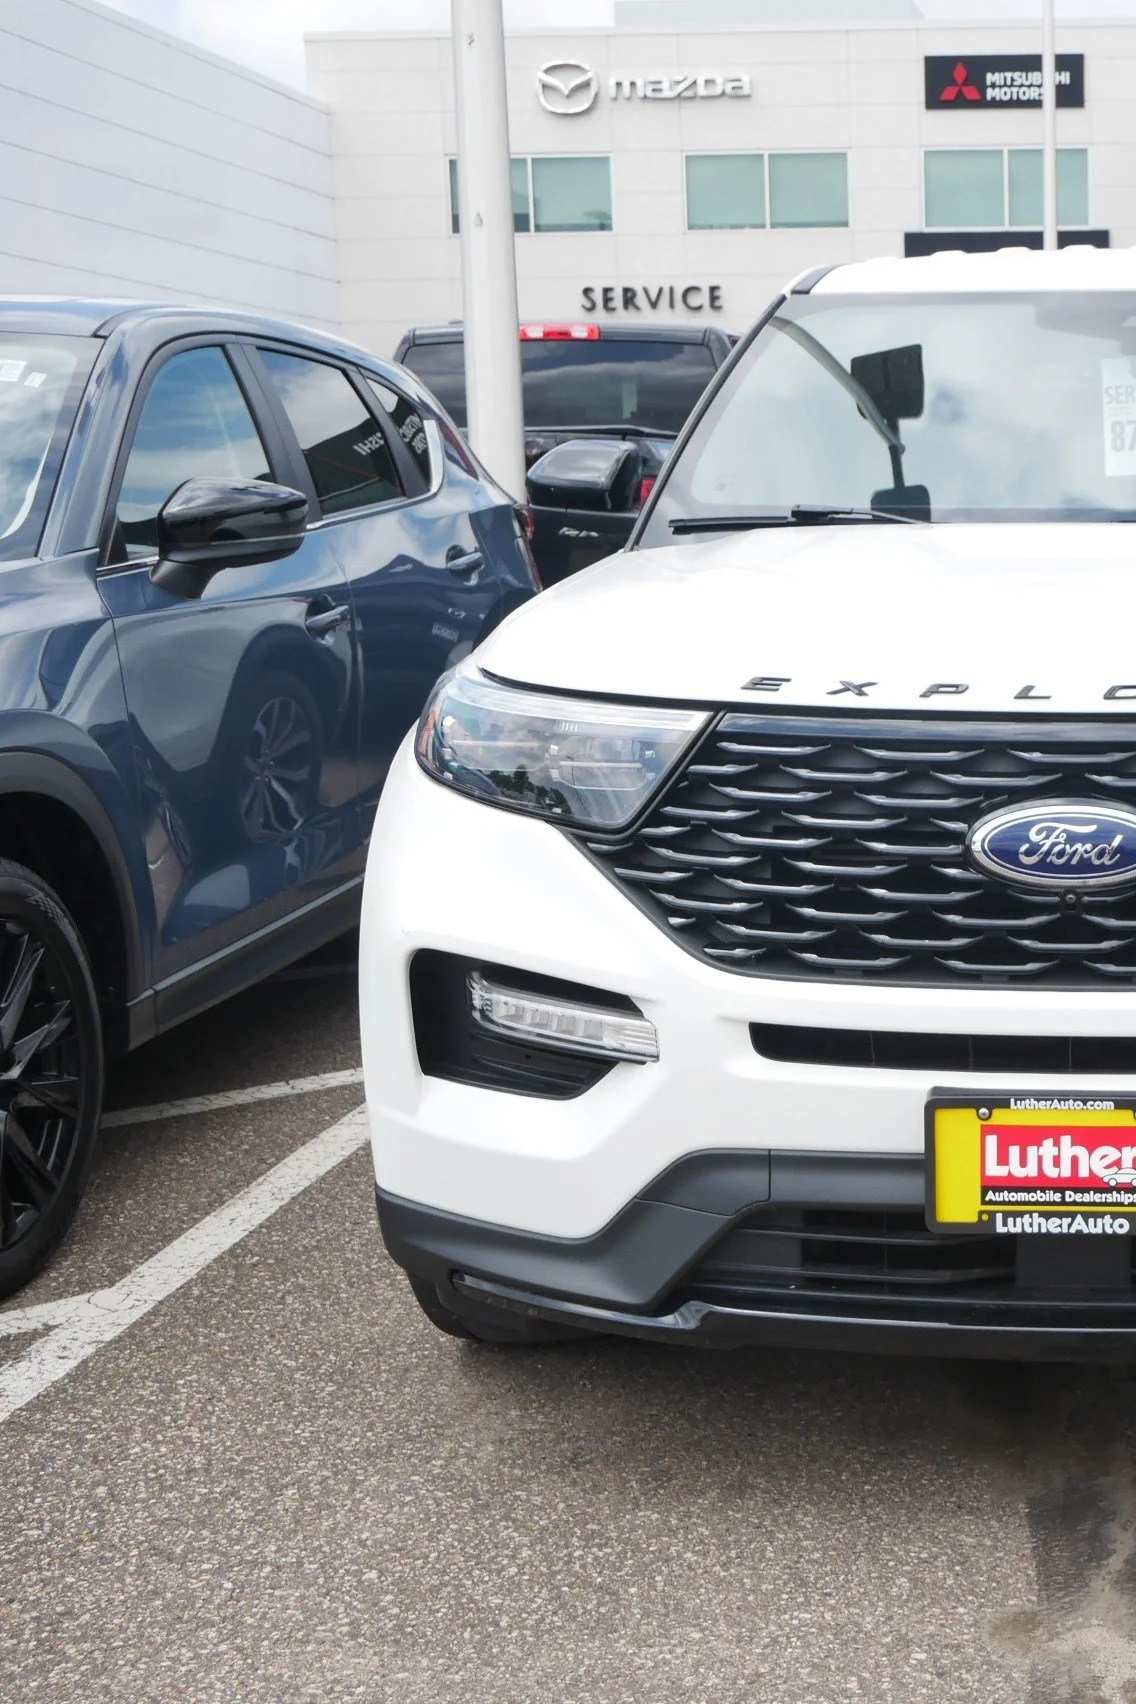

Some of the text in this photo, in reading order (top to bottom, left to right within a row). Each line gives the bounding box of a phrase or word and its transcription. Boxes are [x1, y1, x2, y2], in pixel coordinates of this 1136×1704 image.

[608, 73, 752, 100] mazda
[986, 71, 1070, 85] MITSUBHI
[581, 285, 724, 312] SERVICE
[1018, 822, 1124, 866] Ford
[1010, 1098, 1115, 1111] LutherAuto.com
[985, 1189, 1062, 1203] Automobile
[996, 1213, 1129, 1234] LutherAuto
